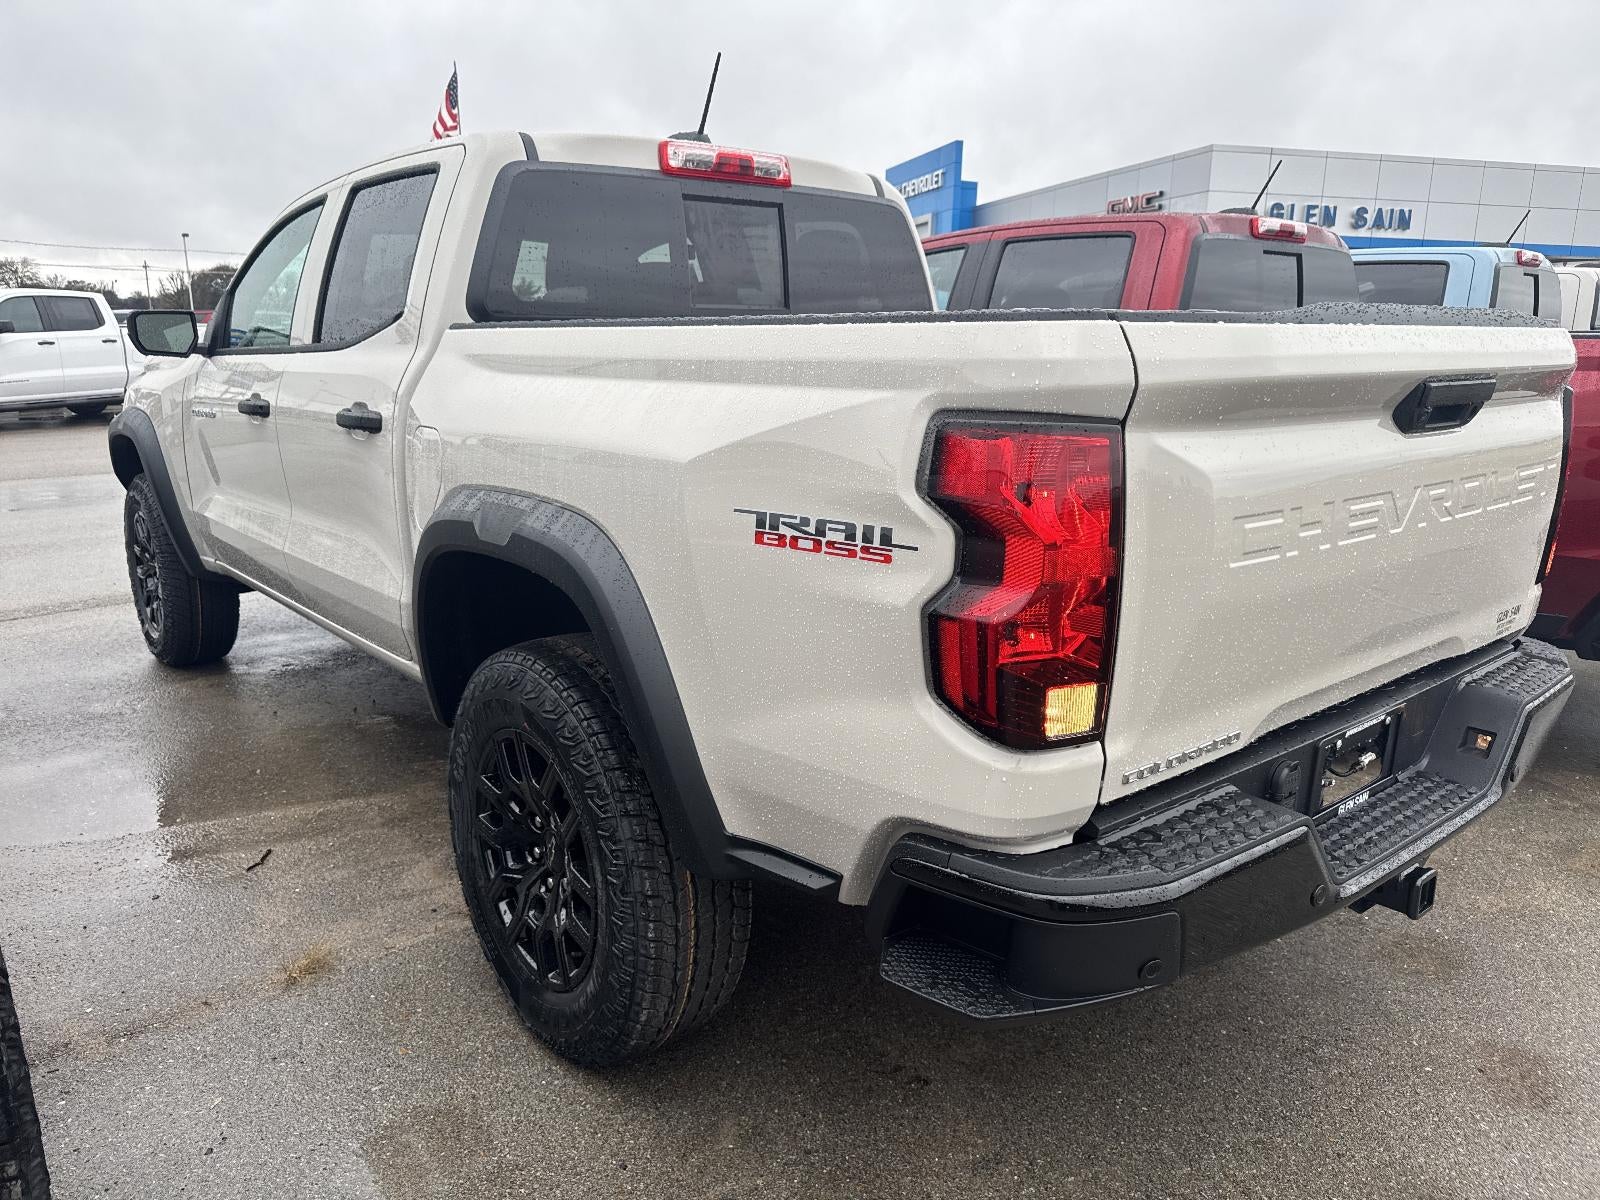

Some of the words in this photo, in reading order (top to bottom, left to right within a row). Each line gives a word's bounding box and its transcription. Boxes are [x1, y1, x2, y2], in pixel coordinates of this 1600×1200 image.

[901, 168, 945, 199] CHEVROLET
[1107, 190, 1164, 215] GMC
[1269, 202, 1338, 228] GLEN
[1351, 206, 1412, 231] SAIN
[733, 508, 919, 552] TRAIL
[754, 530, 894, 570] BOSS
